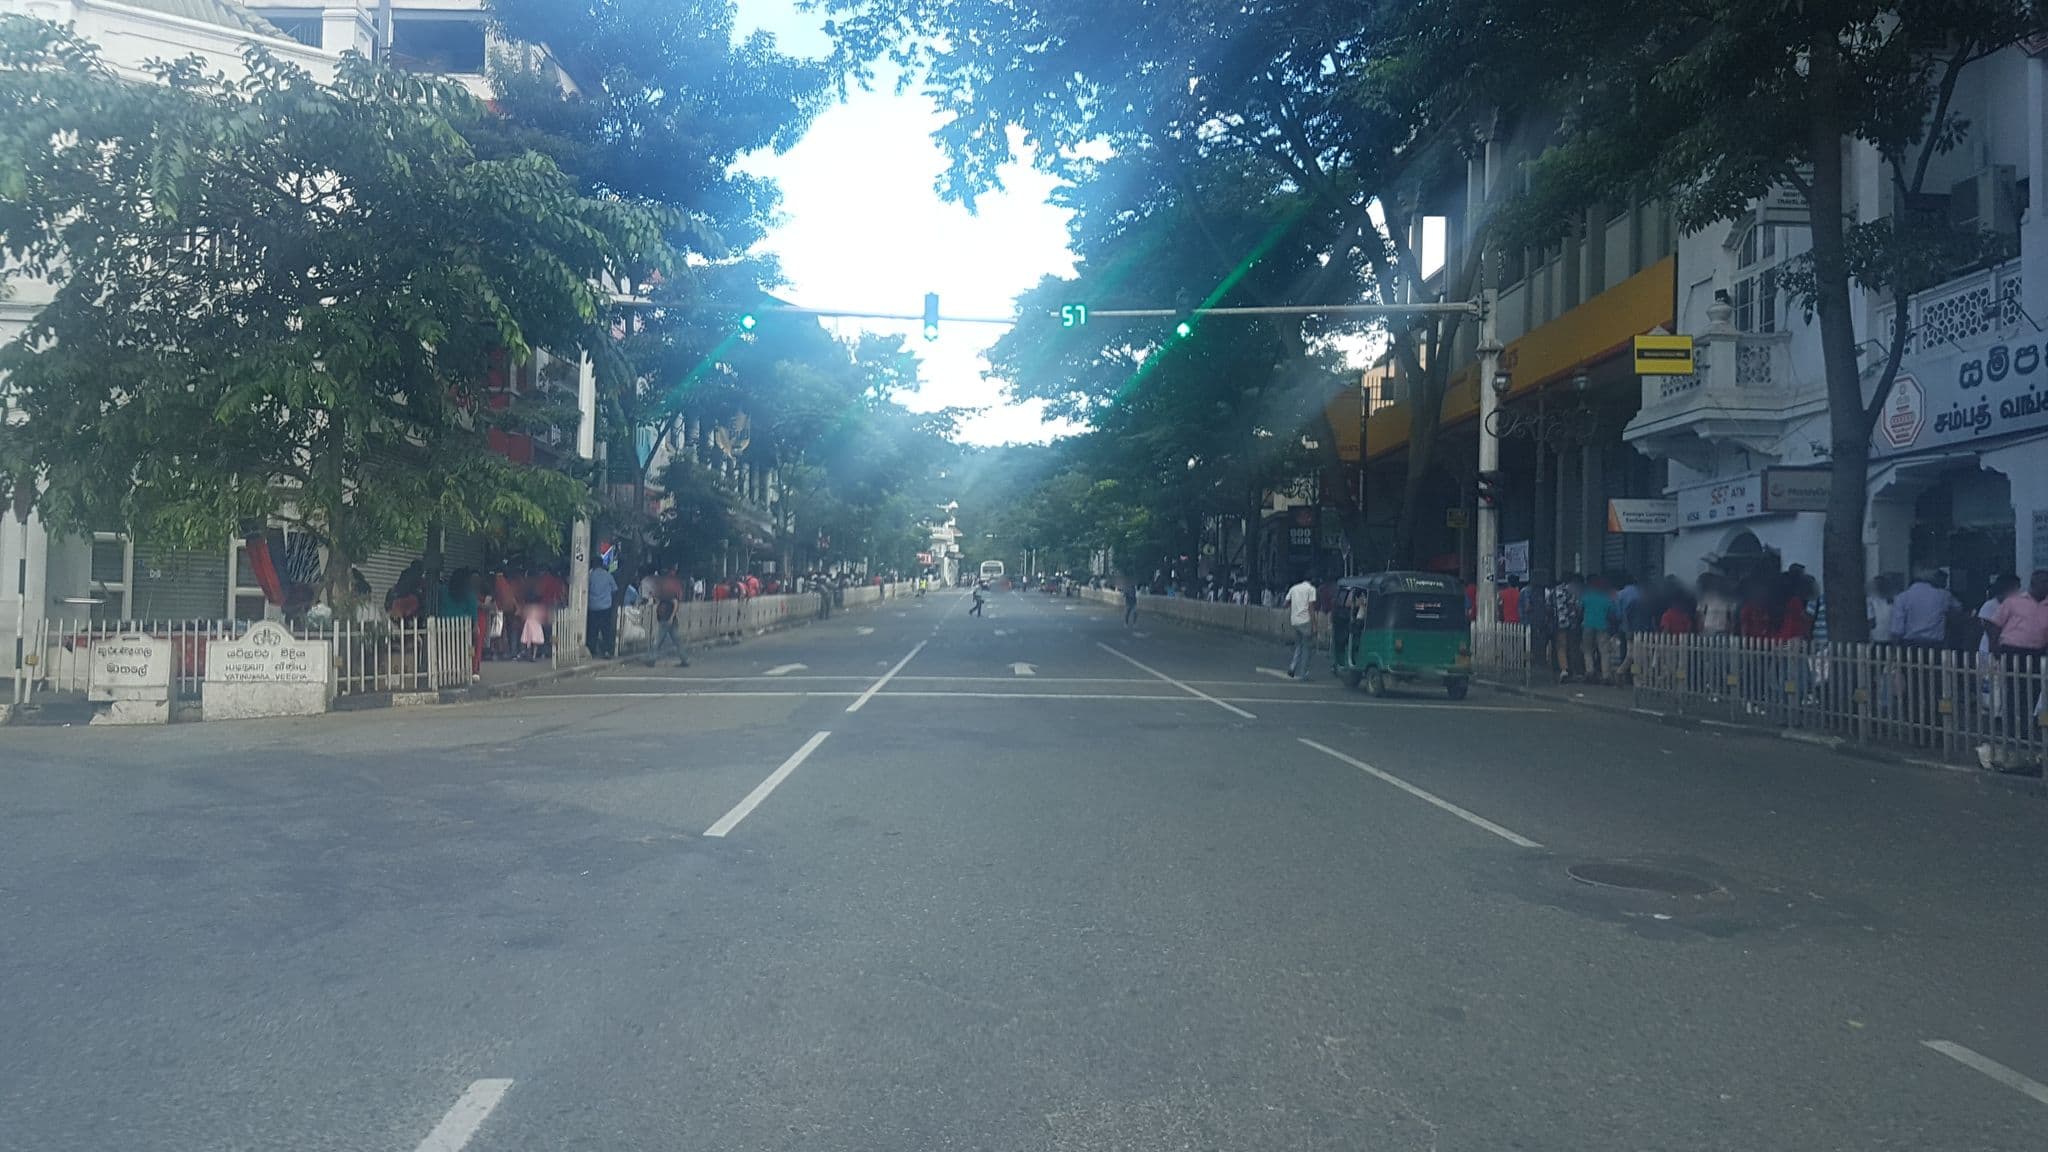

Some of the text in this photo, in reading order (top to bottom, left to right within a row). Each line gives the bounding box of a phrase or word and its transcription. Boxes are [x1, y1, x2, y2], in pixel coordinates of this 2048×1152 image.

[1062, 304, 1086, 327] 57
[1959, 343, 2048, 390] සම්ප
[1934, 394, 1992, 435] சம்பத்
[1731, 487, 1746, 498] ATM
